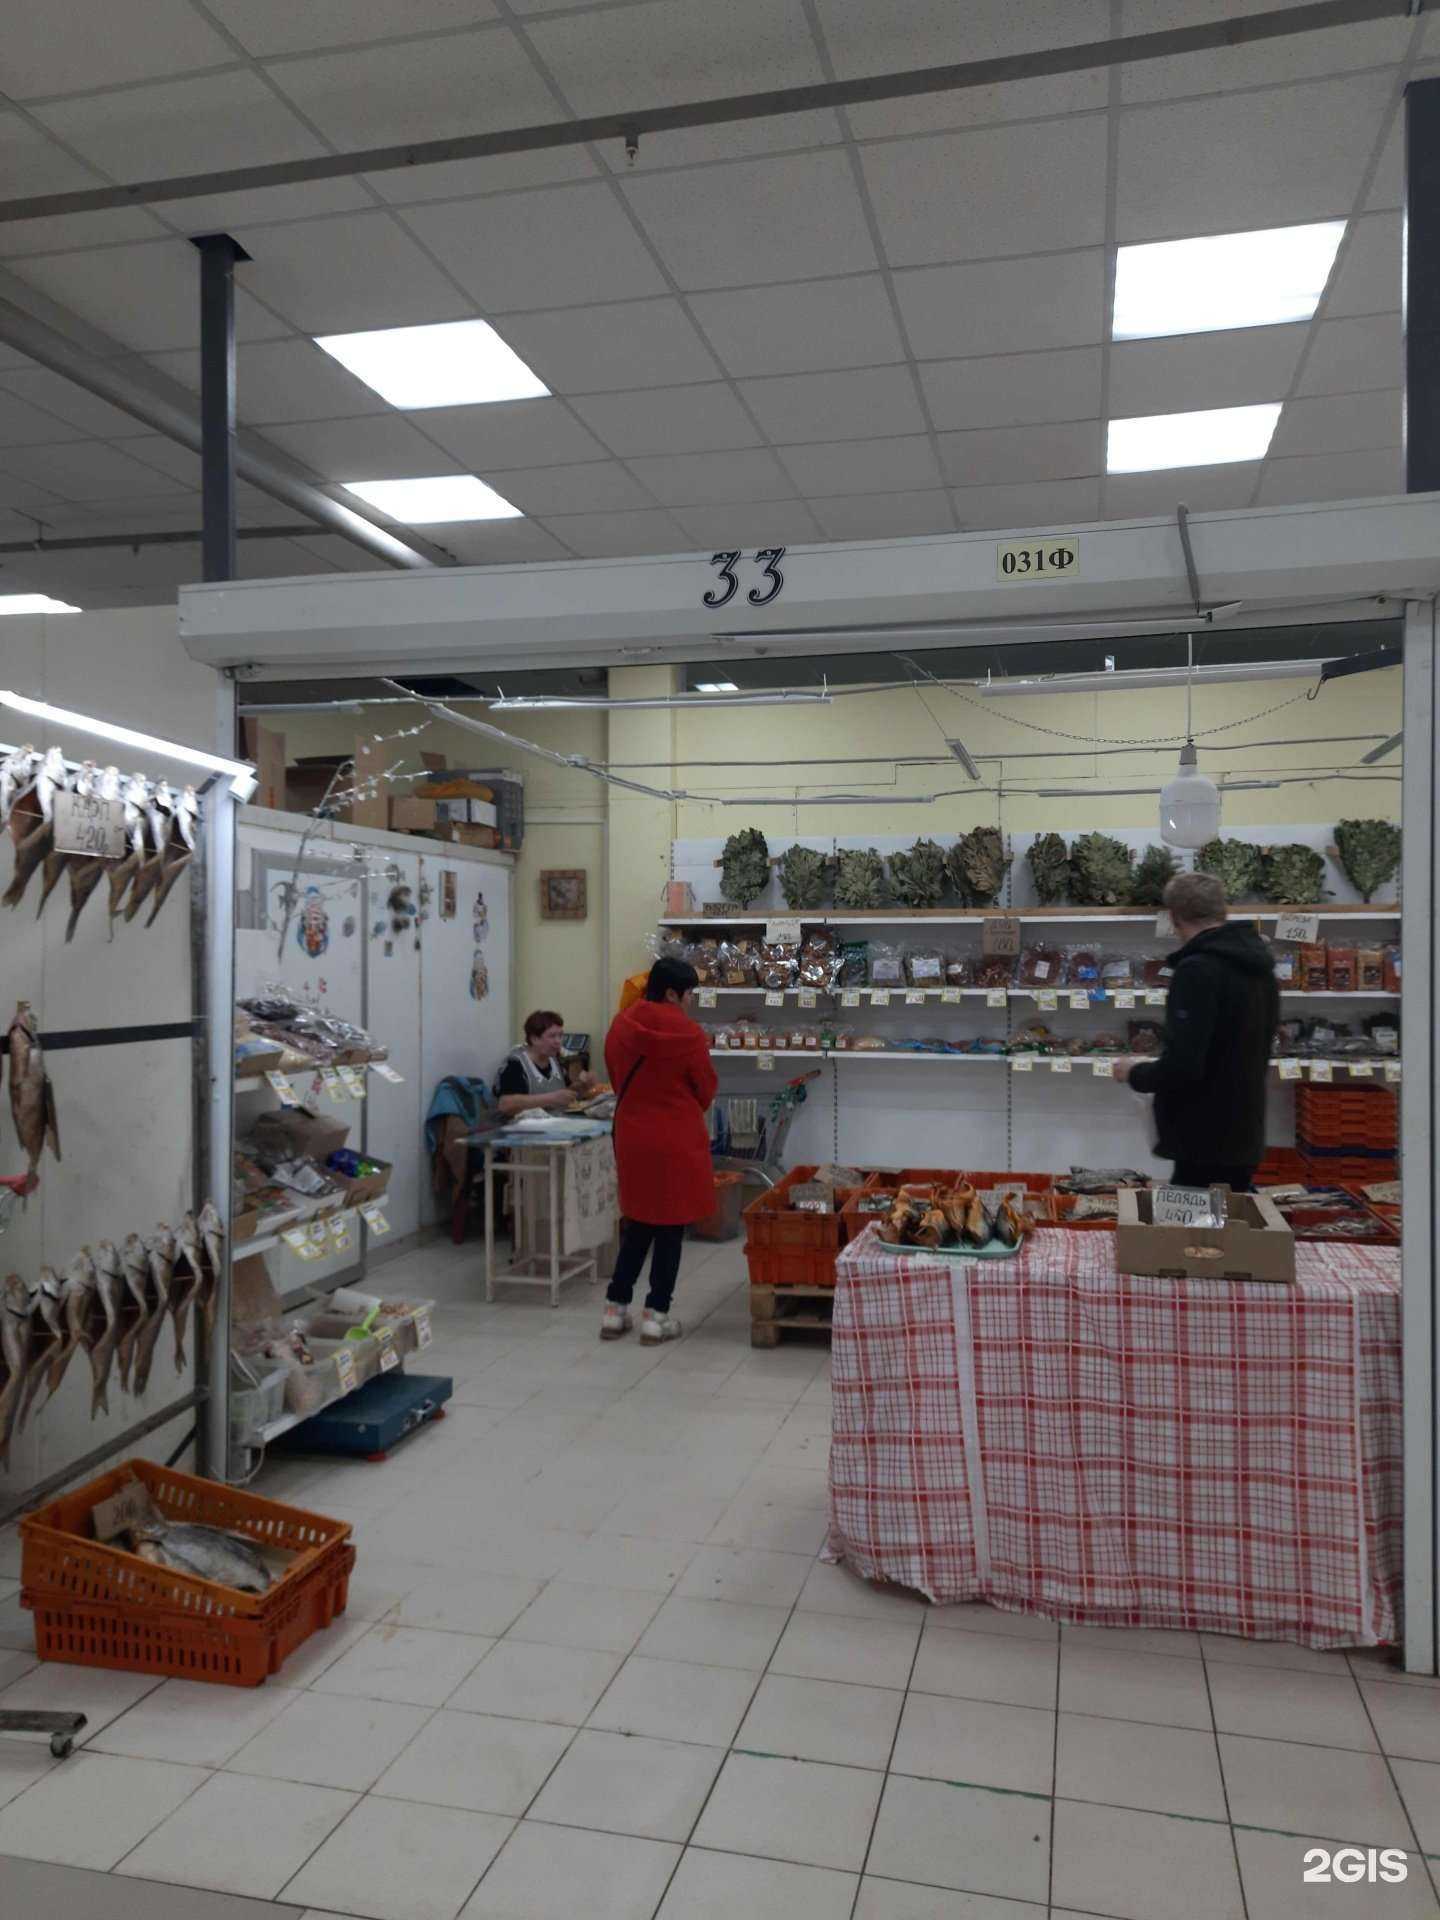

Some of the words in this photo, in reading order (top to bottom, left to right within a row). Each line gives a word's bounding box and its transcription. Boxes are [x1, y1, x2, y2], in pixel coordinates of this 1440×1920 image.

[1001, 547, 1075, 575] 031Ф
[702, 546, 787, 608] 33
[1157, 1190, 1207, 1207] ПЕЛЯДЬ
